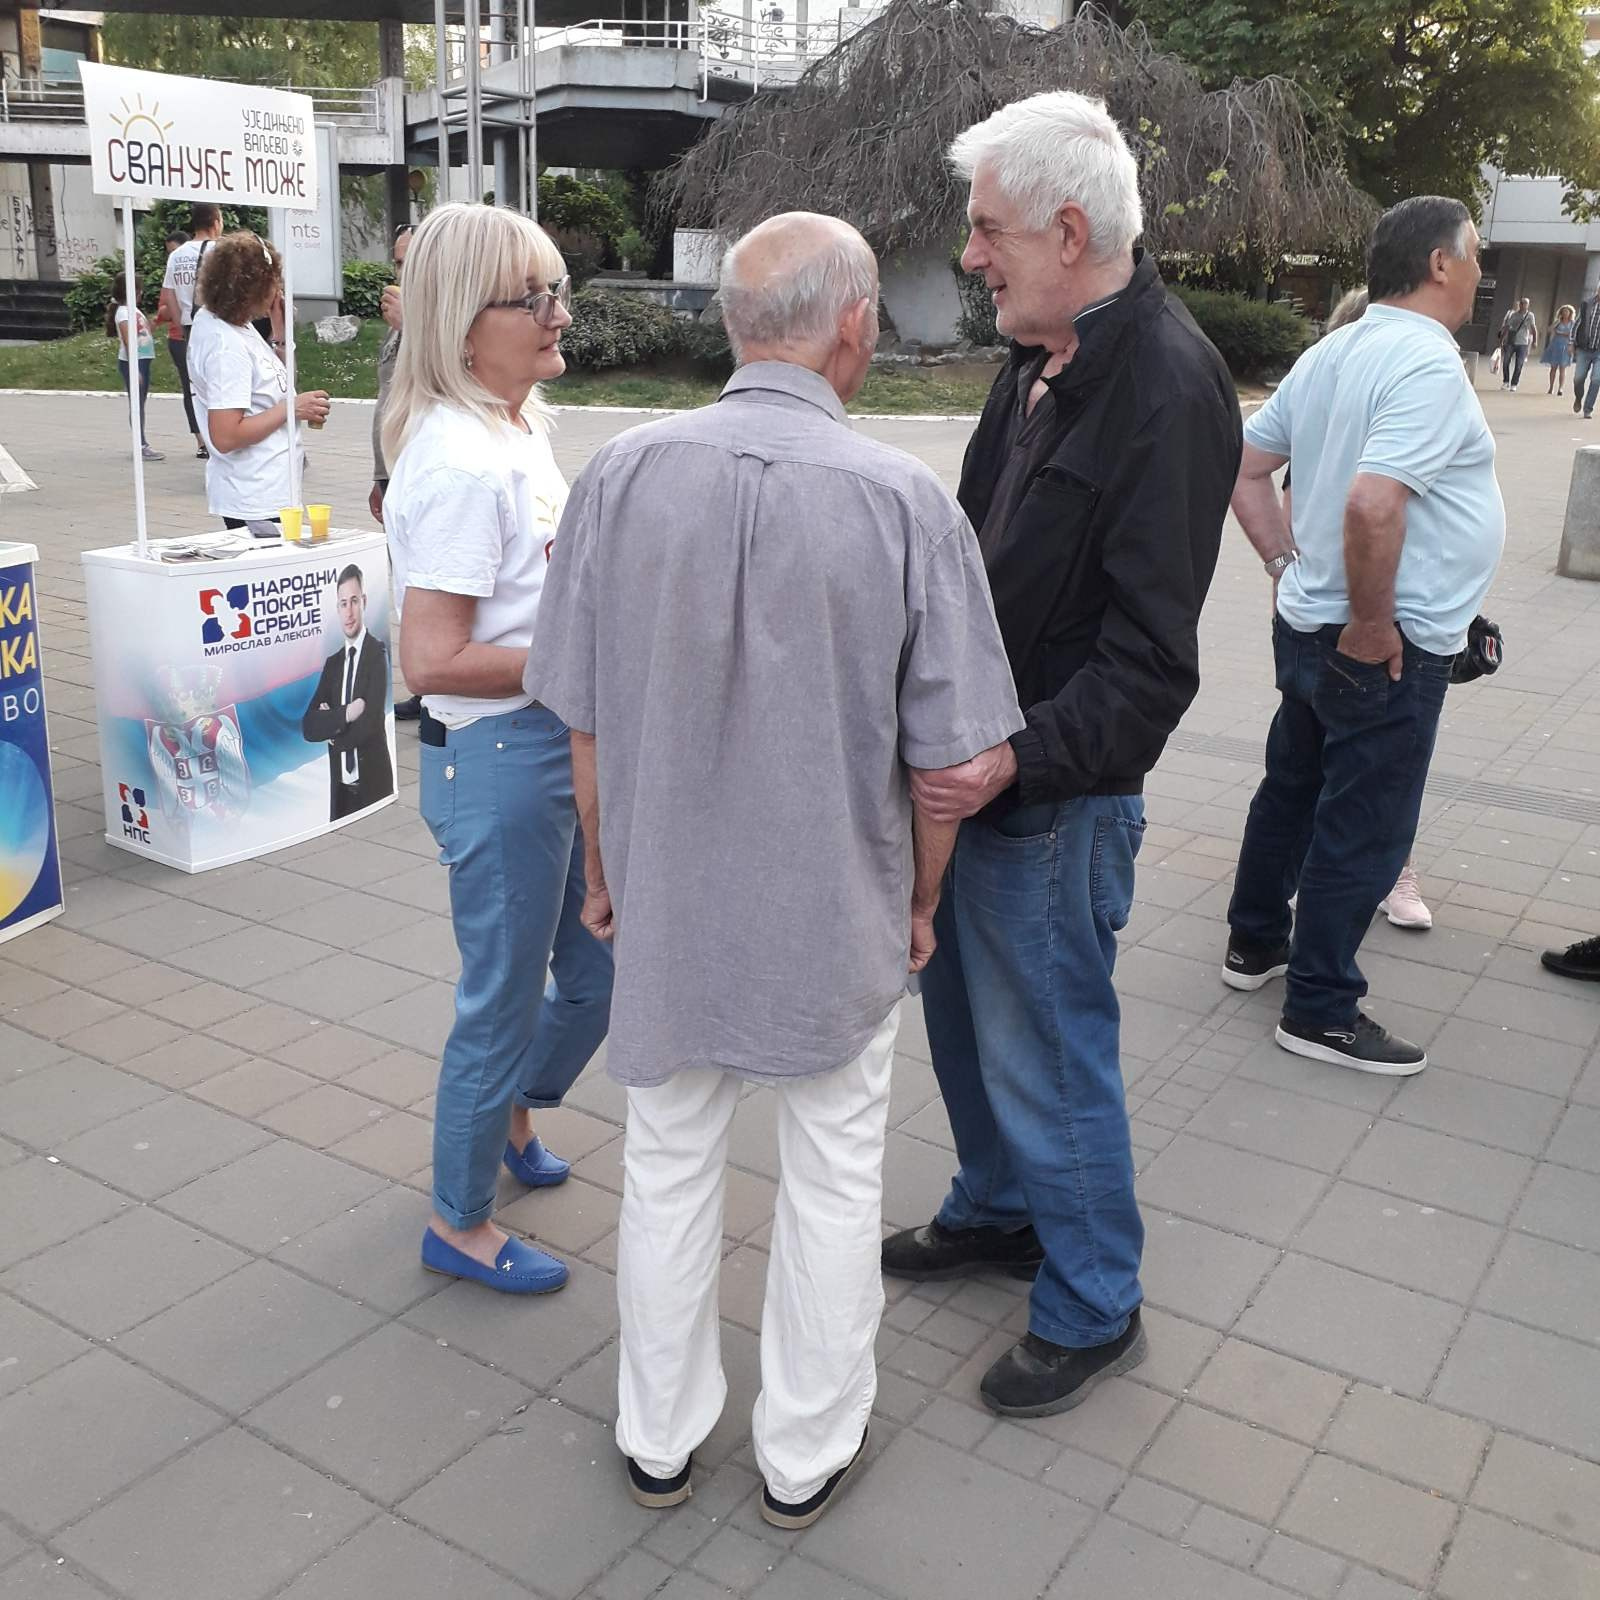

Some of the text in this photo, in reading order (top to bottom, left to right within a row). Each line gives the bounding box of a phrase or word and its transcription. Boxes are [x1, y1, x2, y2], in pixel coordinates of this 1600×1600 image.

[242, 108, 304, 135] УЈЕДИЊЕНО
[244, 132, 288, 155] ВАЉЕВО
[107, 138, 234, 191] СВАНУЋЕ
[245, 157, 306, 197] МОЖЕ
[251, 568, 337, 598] НАРОДНИ
[253, 589, 323, 617] ПОКРЕТ
[254, 608, 321, 635] СРБИЈЕ
[0, 632, 37, 680] КА
[204, 626, 322, 657] МИРОСЛАВ АЛЕКСИЋ
[123, 823, 151, 845] НПС
